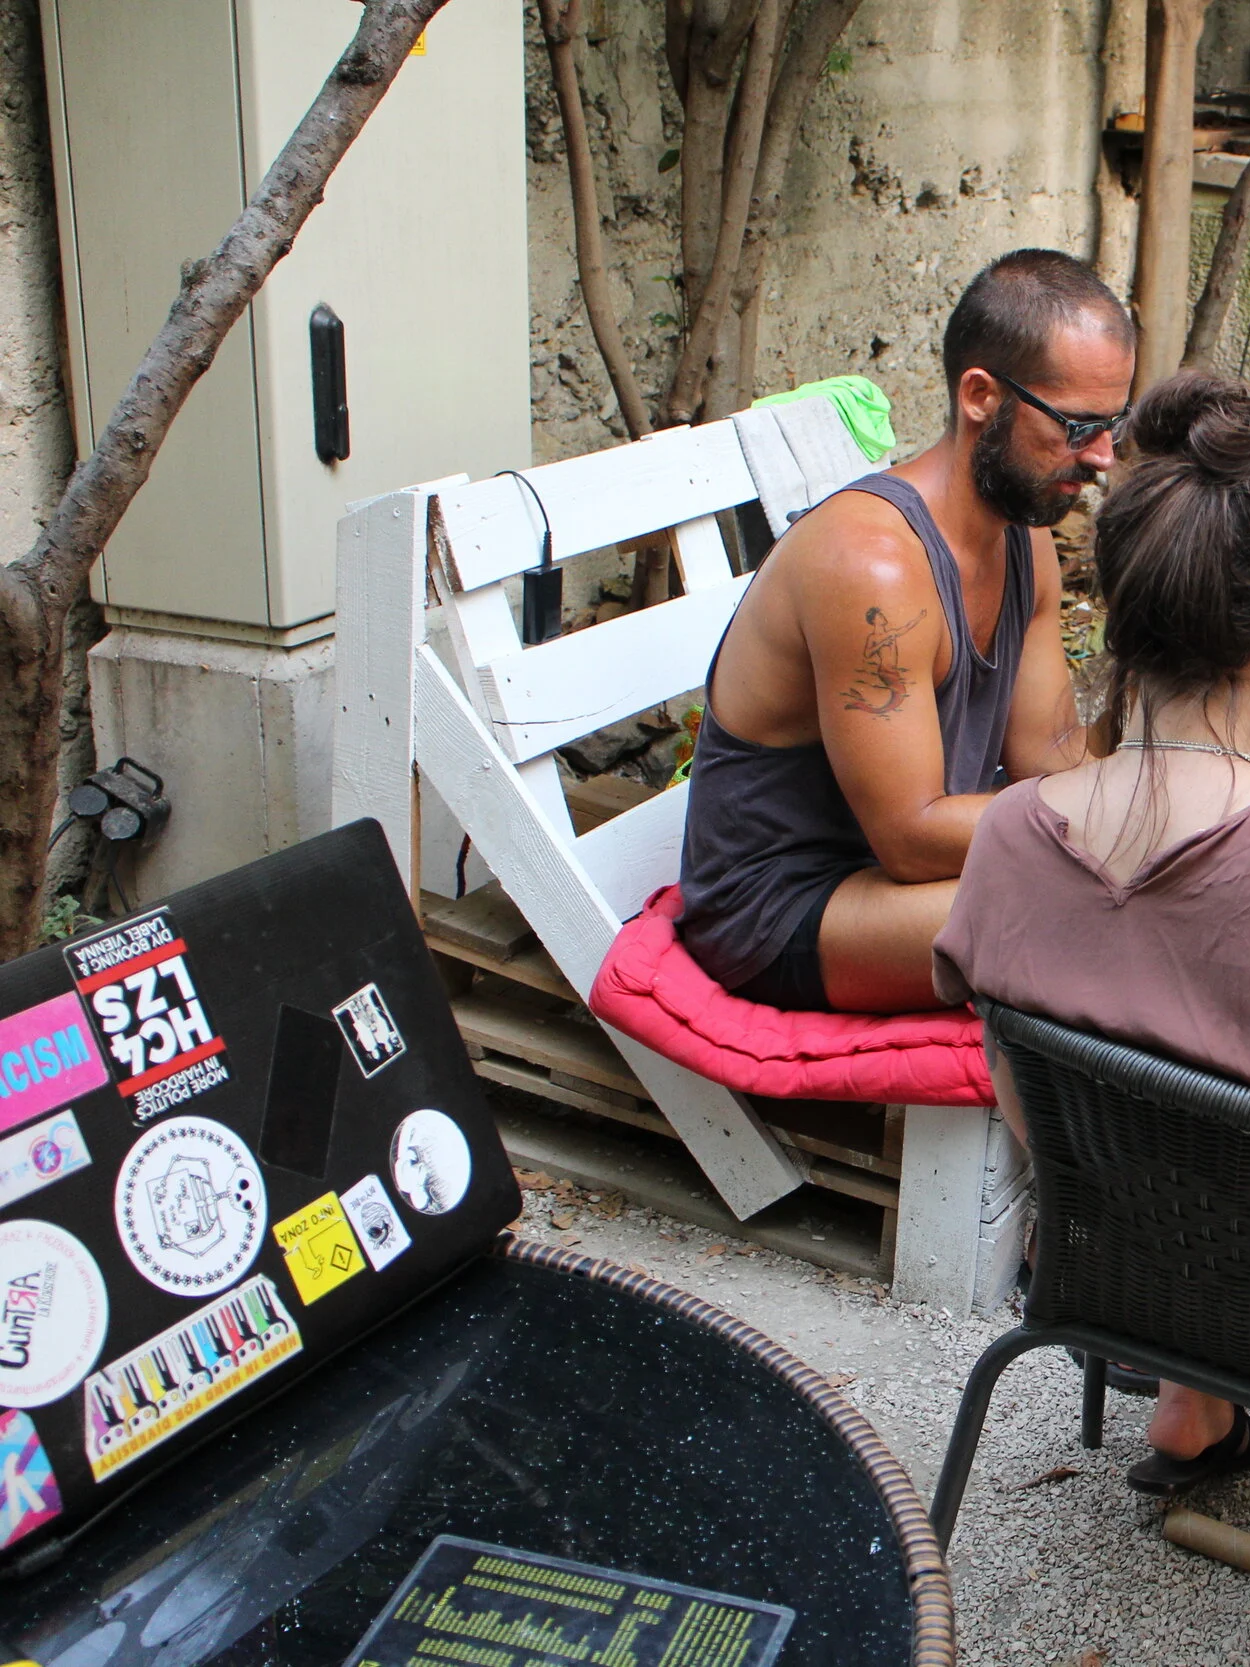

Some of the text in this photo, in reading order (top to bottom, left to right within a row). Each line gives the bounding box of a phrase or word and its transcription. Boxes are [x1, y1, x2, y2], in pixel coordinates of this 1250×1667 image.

[74, 916, 166, 963] LABEL VIENNA
[78, 927, 174, 976] DIY BOOKING &
[92, 954, 197, 1034] LZS
[0, 1023, 92, 1099] CISM
[110, 998, 214, 1077] HC4
[134, 1055, 221, 1106] IN HARDCORE
[136, 1064, 230, 1121] MORE POLITICS
[279, 1203, 336, 1244] INFO ZONA
[100, 1336, 297, 1473] HAND IN HAND FOR DIVERSITY
